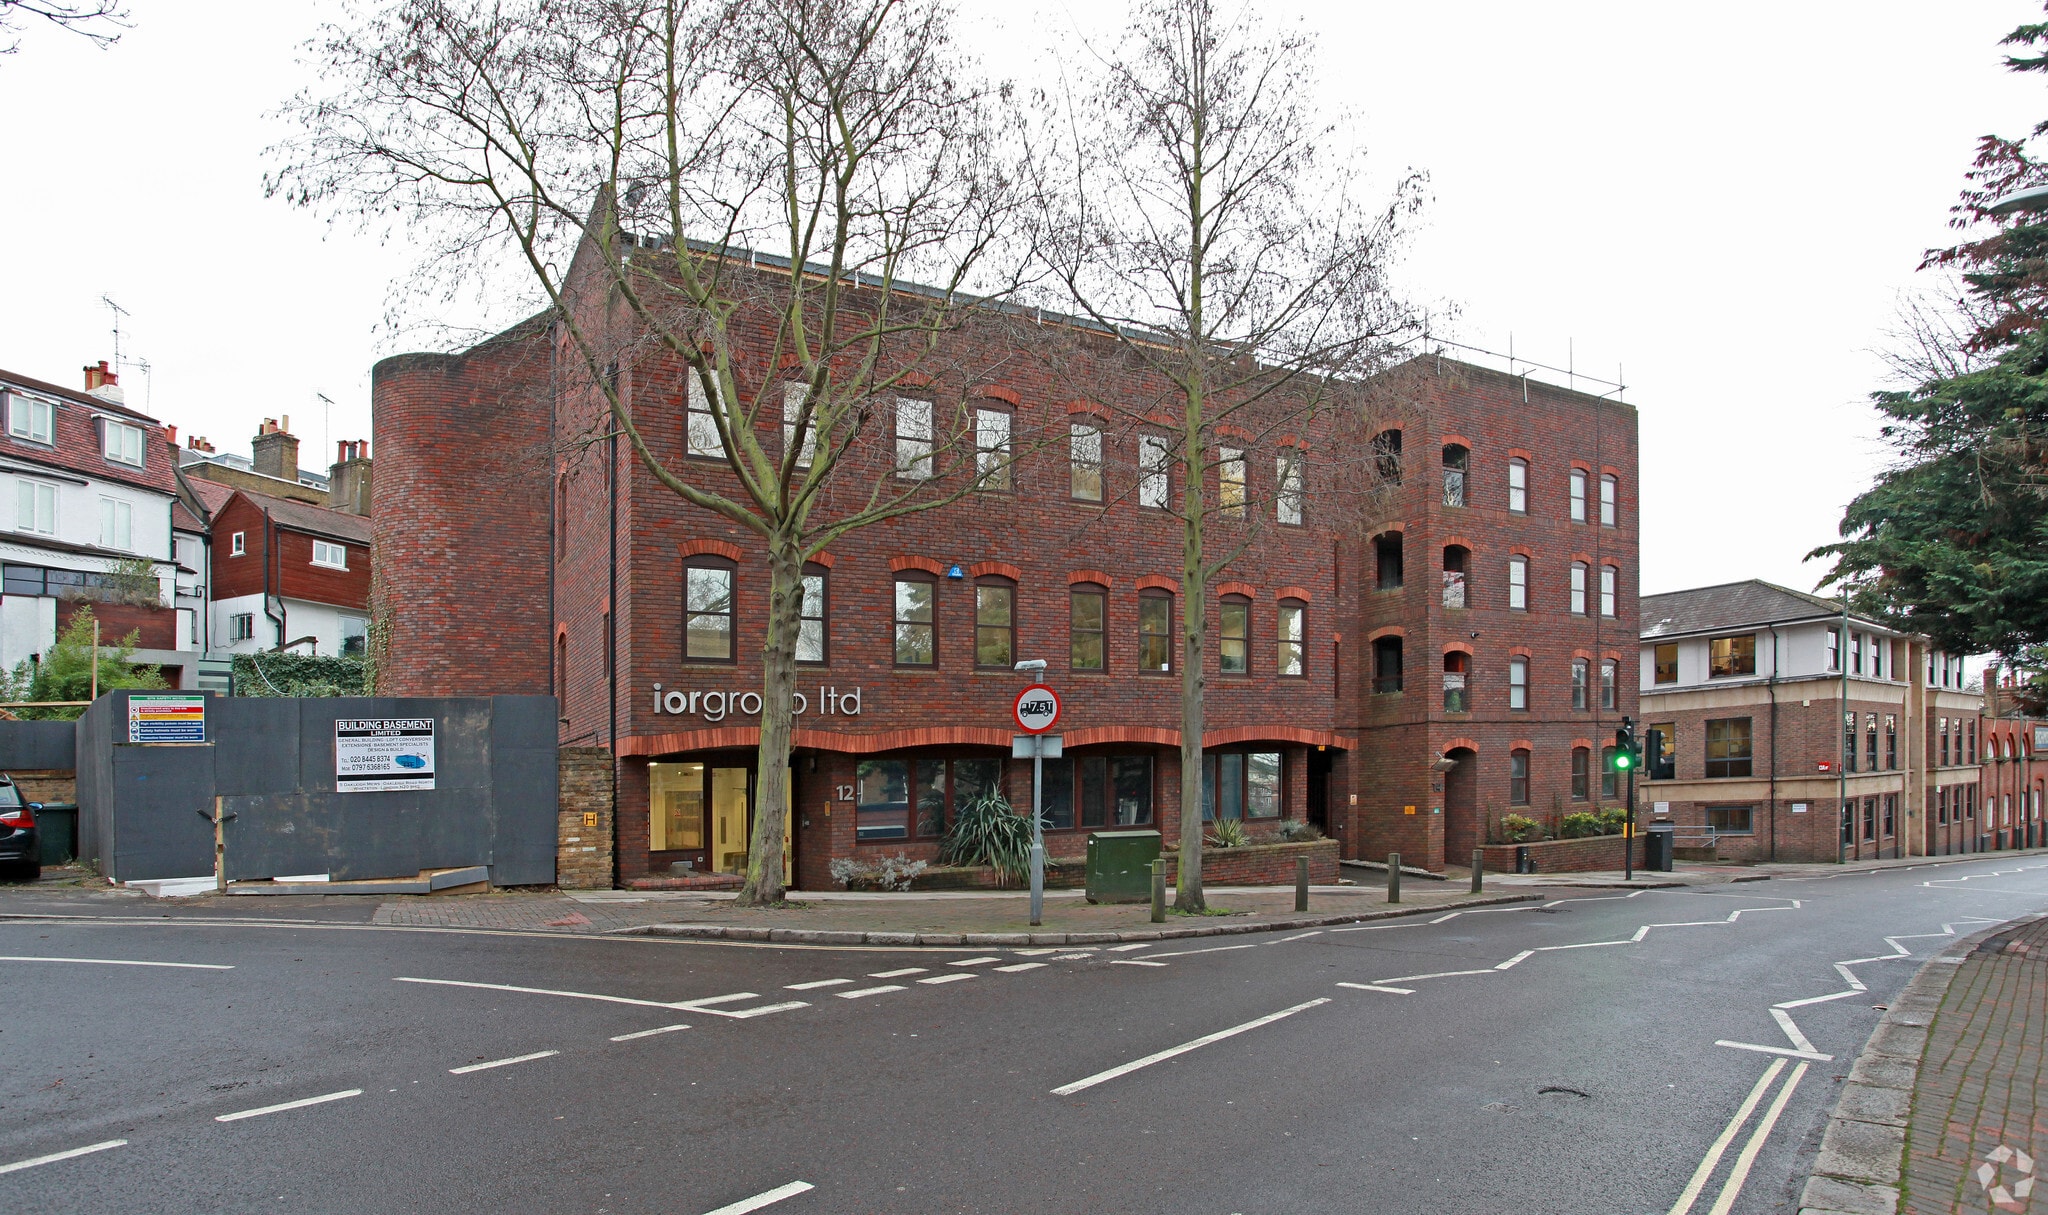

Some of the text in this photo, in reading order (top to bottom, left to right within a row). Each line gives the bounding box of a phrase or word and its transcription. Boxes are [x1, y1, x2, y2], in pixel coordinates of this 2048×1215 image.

[653, 682, 861, 722] iorgrop ltd
[1030, 701, 1053, 712] 7.5T
[338, 720, 432, 730] BUILDING BASEMENT
[836, 785, 855, 801] 12
[585, 813, 596, 826] H
